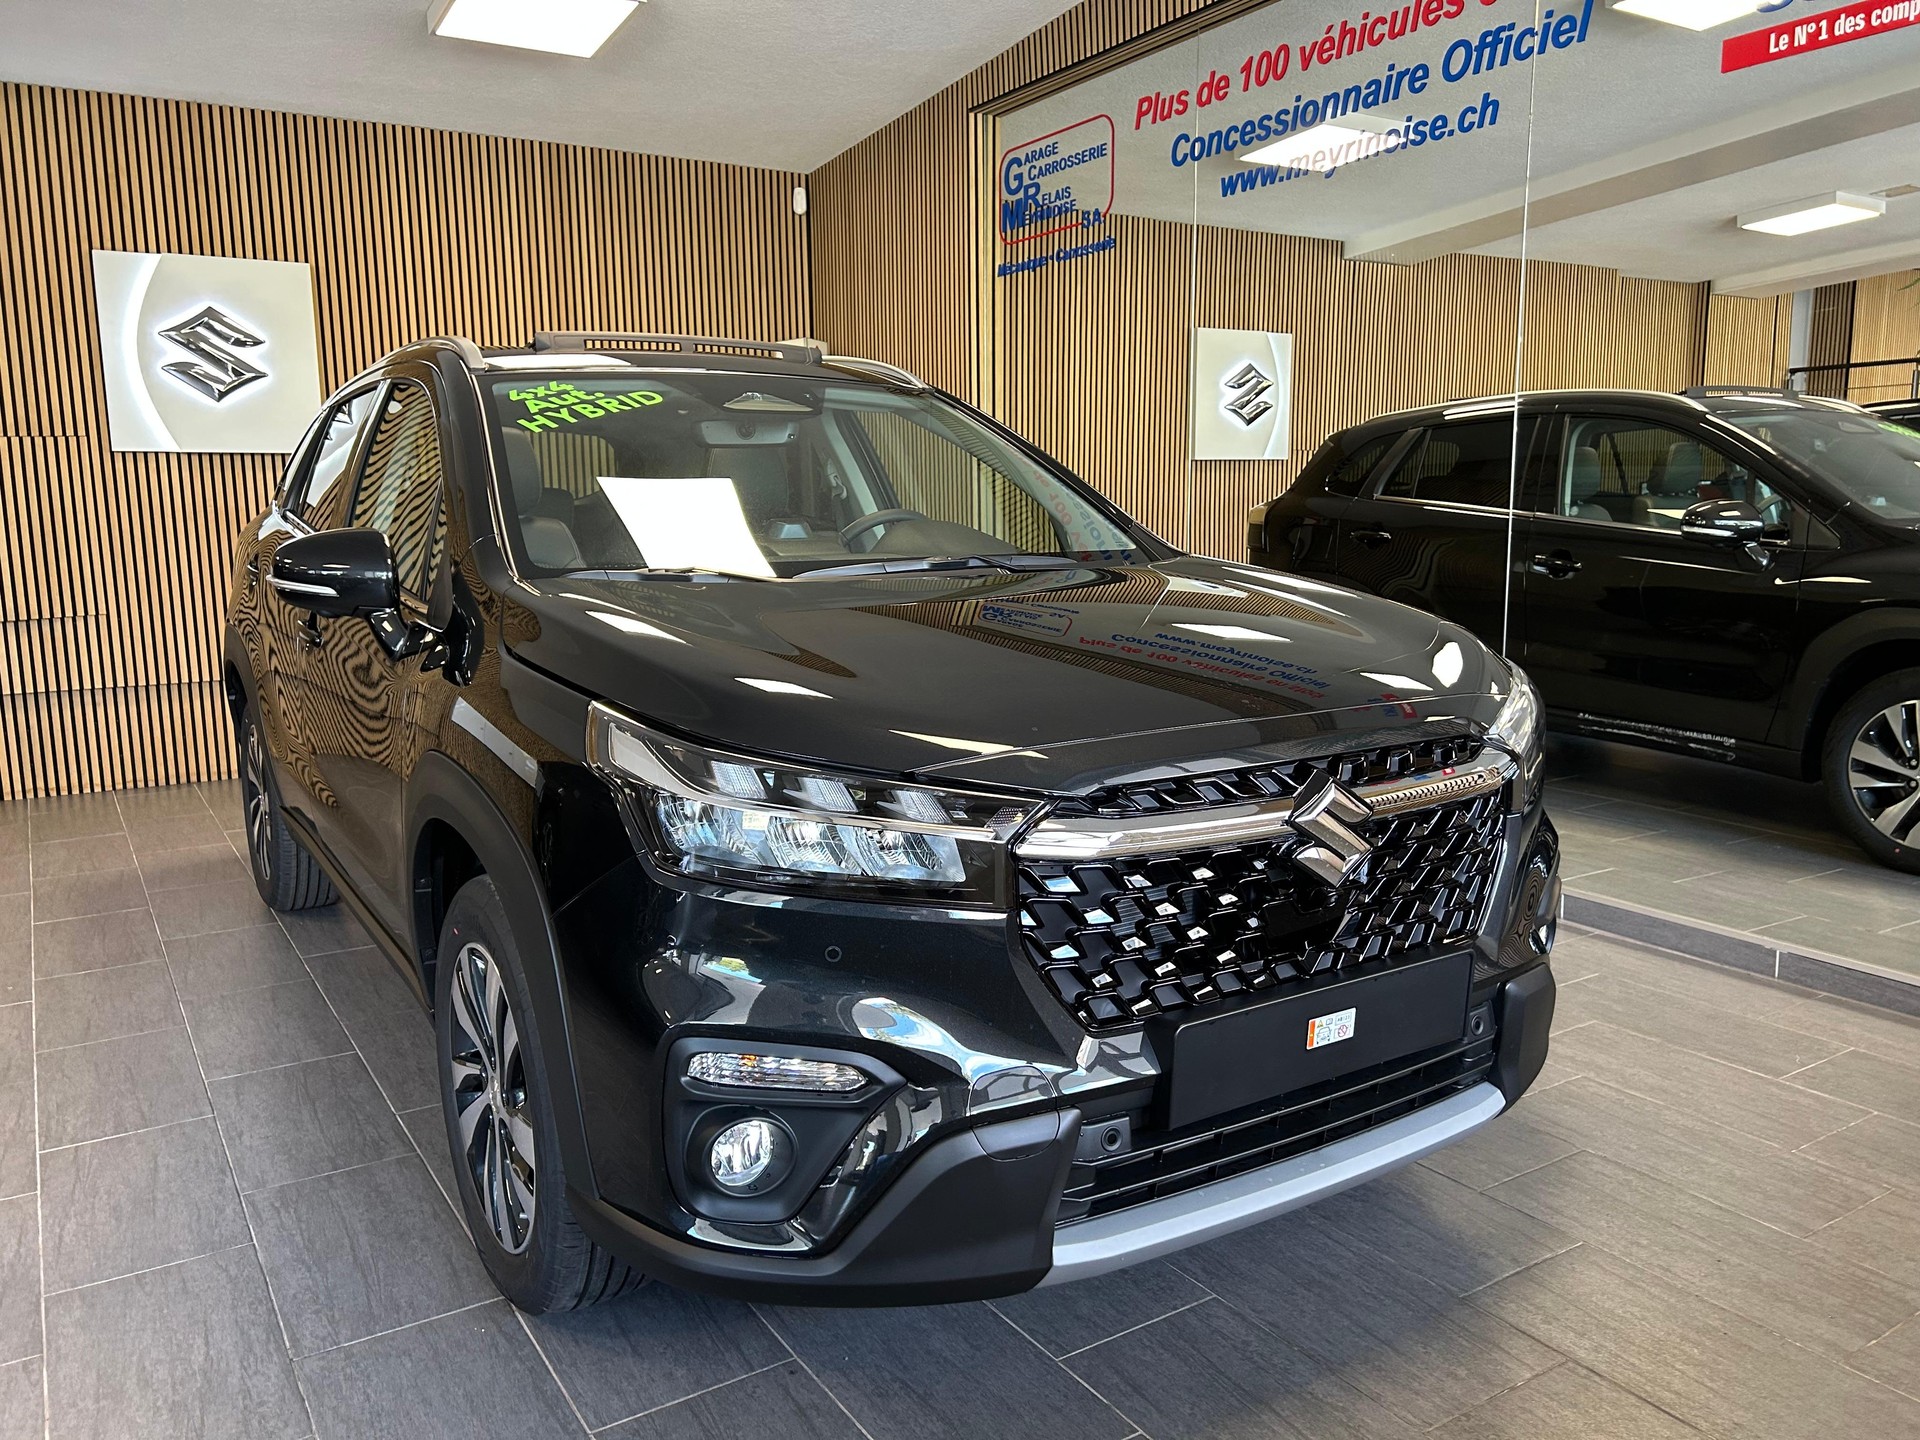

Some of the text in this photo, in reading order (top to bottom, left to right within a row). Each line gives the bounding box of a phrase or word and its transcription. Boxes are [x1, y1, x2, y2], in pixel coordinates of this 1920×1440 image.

[1769, 32, 1789, 54] Le
[1834, 13, 1866, 36] des
[1134, 0, 1466, 131] Plus de 100 véhicules
[1171, 0, 1593, 168] Concessionnaire Officiel
[1027, 142, 1107, 181] CARROSSERIE
[1220, 92, 1500, 198] www.meyrinoise.ch
[1004, 141, 1059, 196] GARAGE
[508, 380, 575, 401] 4x4
[517, 390, 663, 433] HYBRID
[524, 388, 605, 414] Aut.
